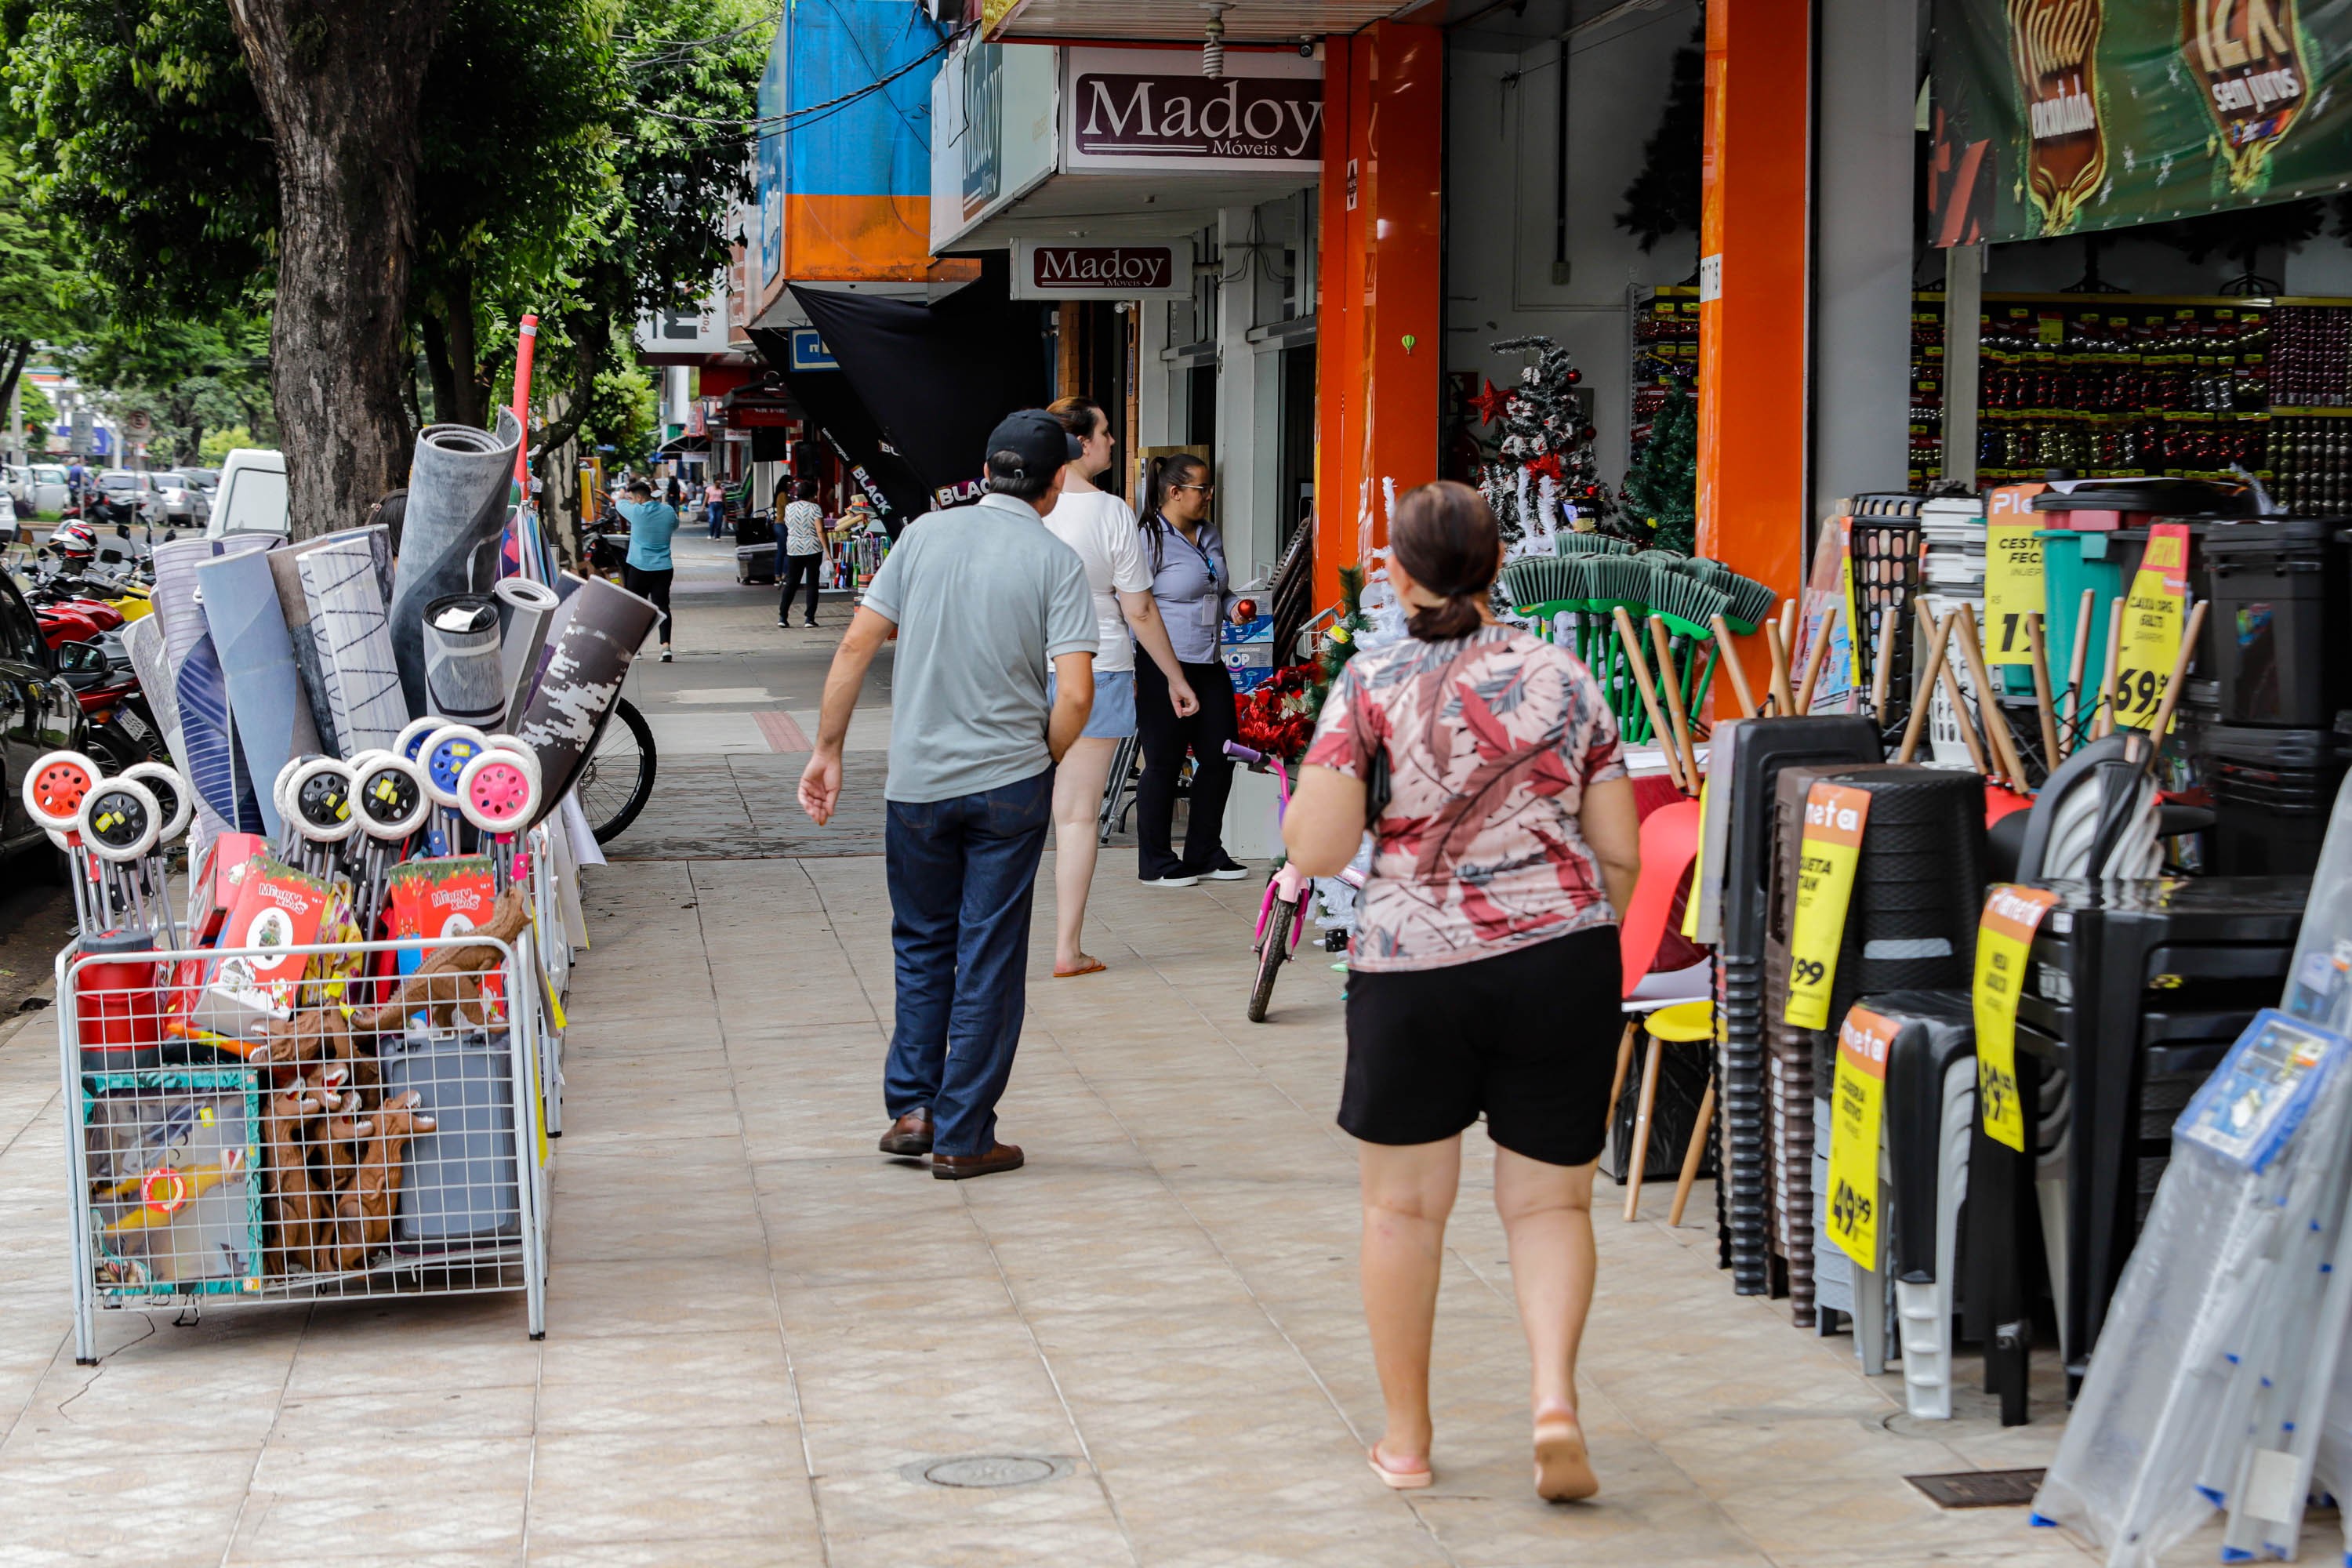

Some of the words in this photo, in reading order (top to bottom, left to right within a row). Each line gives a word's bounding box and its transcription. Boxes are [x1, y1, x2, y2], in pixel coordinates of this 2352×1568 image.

[1082, 80, 1323, 156] Madoy
[1212, 139, 1278, 157] Móveis
[1040, 248, 1164, 286] Madoy
[1106, 278, 1141, 287] Móveis
[852, 466, 892, 515] BLACK
[938, 477, 991, 506] BLAC
[2009, 552, 2043, 564] FEC
